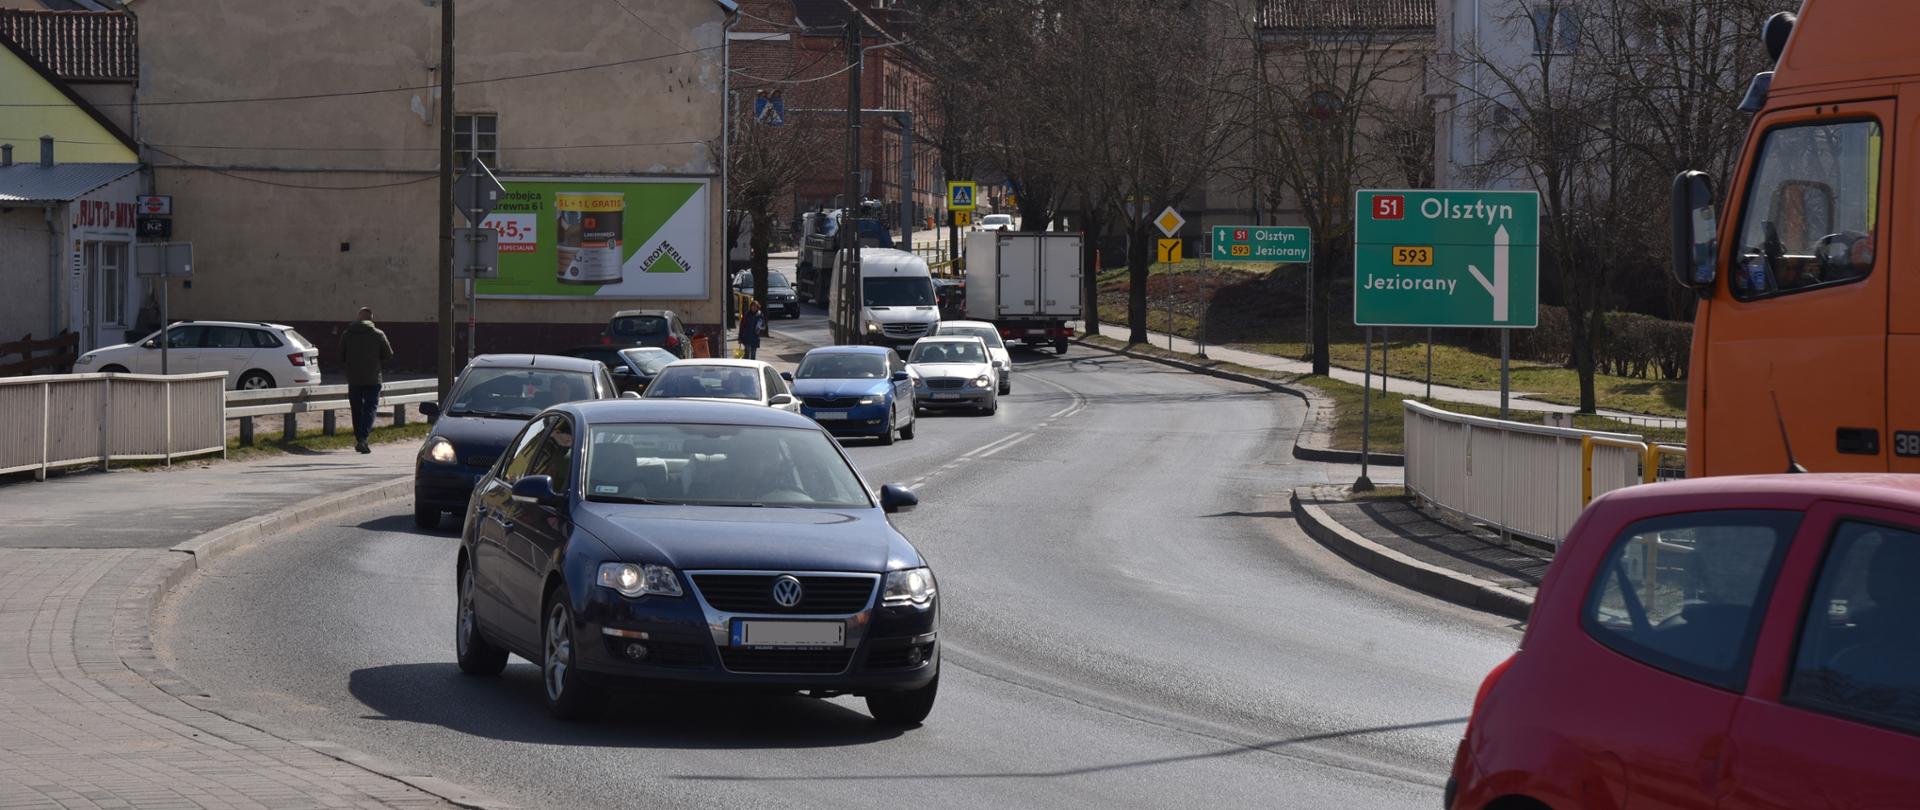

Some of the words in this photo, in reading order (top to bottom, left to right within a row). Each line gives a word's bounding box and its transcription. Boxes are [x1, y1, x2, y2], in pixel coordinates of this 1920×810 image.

[503, 191, 541, 202] robejca
[79, 200, 136, 230] AUTO-MIX
[1379, 199, 1397, 216] 51
[1420, 198, 1513, 226] Olsztyn
[147, 223, 162, 231] K2
[1236, 231, 1247, 239] 51
[1255, 230, 1295, 243] Olsztyn
[639, 245, 664, 272] LEROY
[660, 240, 692, 272] MERLIN
[1232, 246, 1249, 254] 593
[1255, 245, 1307, 259] Jeziorany
[1398, 249, 1427, 263] 593
[1363, 273, 1457, 295] Jeziorany
